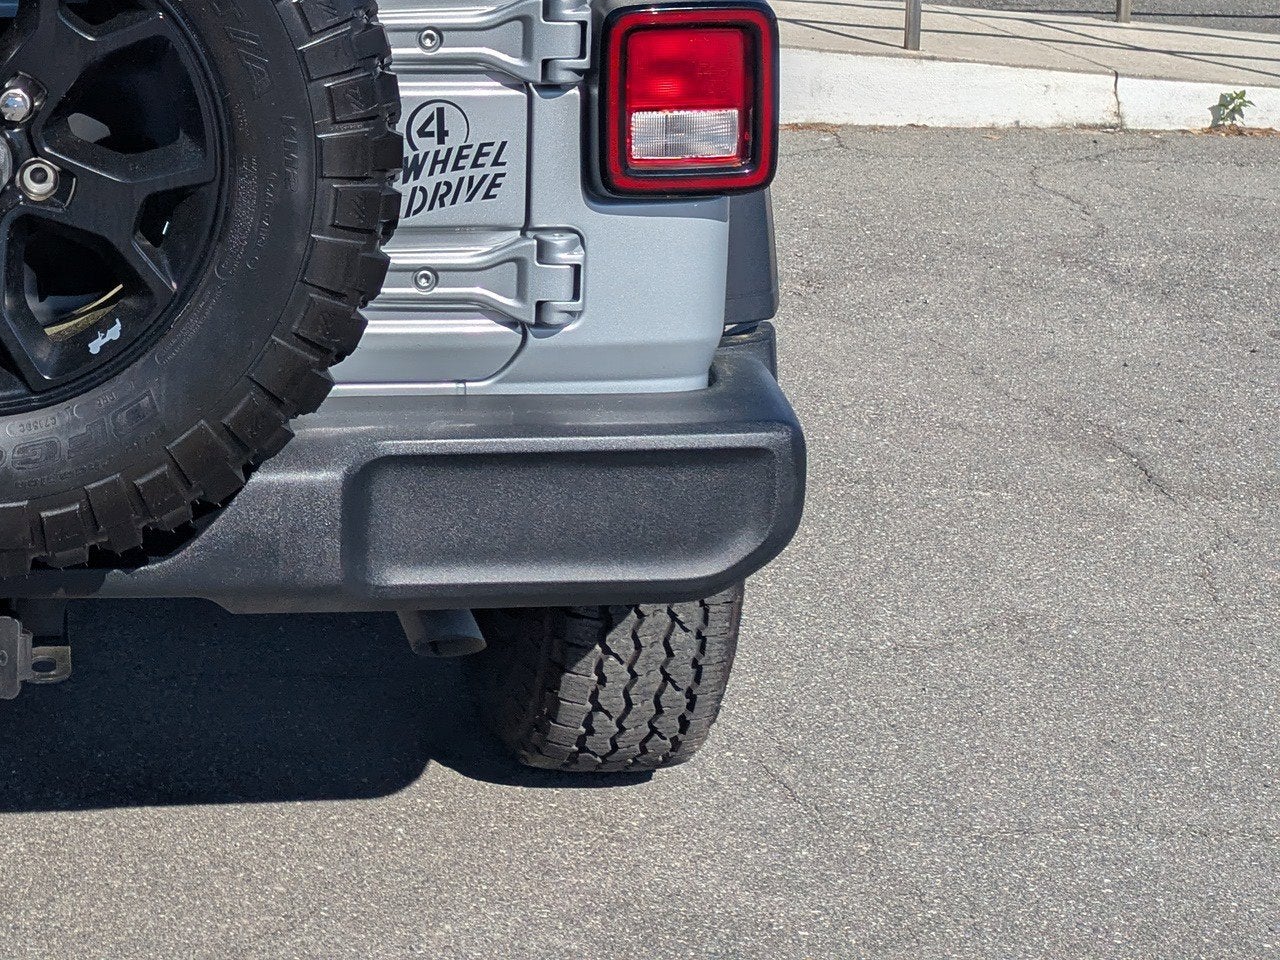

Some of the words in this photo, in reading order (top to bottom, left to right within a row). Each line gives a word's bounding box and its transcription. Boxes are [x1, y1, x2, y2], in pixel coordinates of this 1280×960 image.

[416, 106, 450, 146] 4
[402, 140, 508, 186] WHEEL
[404, 172, 507, 219] DRIVE
